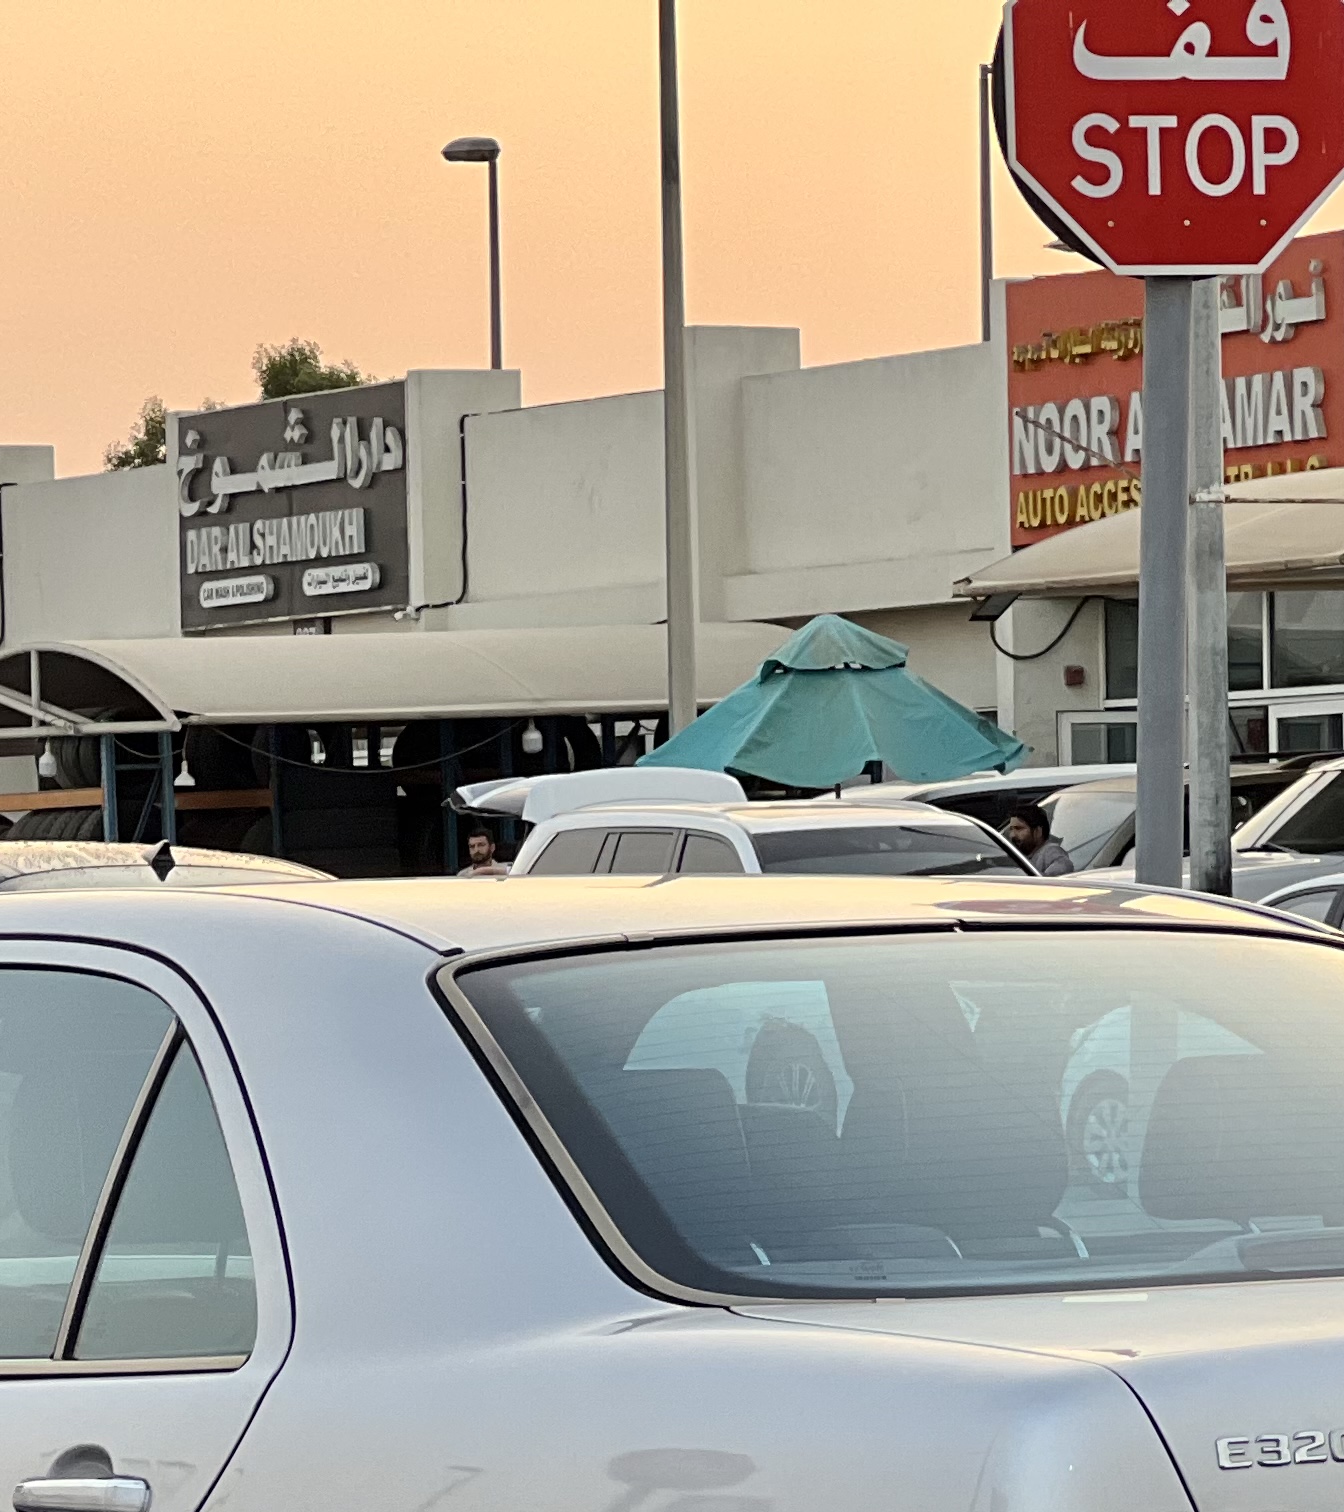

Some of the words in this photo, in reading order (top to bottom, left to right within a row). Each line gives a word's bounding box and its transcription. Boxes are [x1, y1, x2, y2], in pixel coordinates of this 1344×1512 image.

[1070, 112, 1299, 198] STOP
[348, 416, 403, 489] دار
[1013, 395, 1117, 475] NOOR
[1124, 391, 1143, 462] A
[1221, 367, 1325, 448] AMAR
[1016, 485, 1070, 528] AUTO
[1075, 478, 1142, 522] ACCES
[186, 525, 225, 574] DAR
[226, 522, 252, 568] AL
[253, 508, 365, 566] SHAMOUKH
